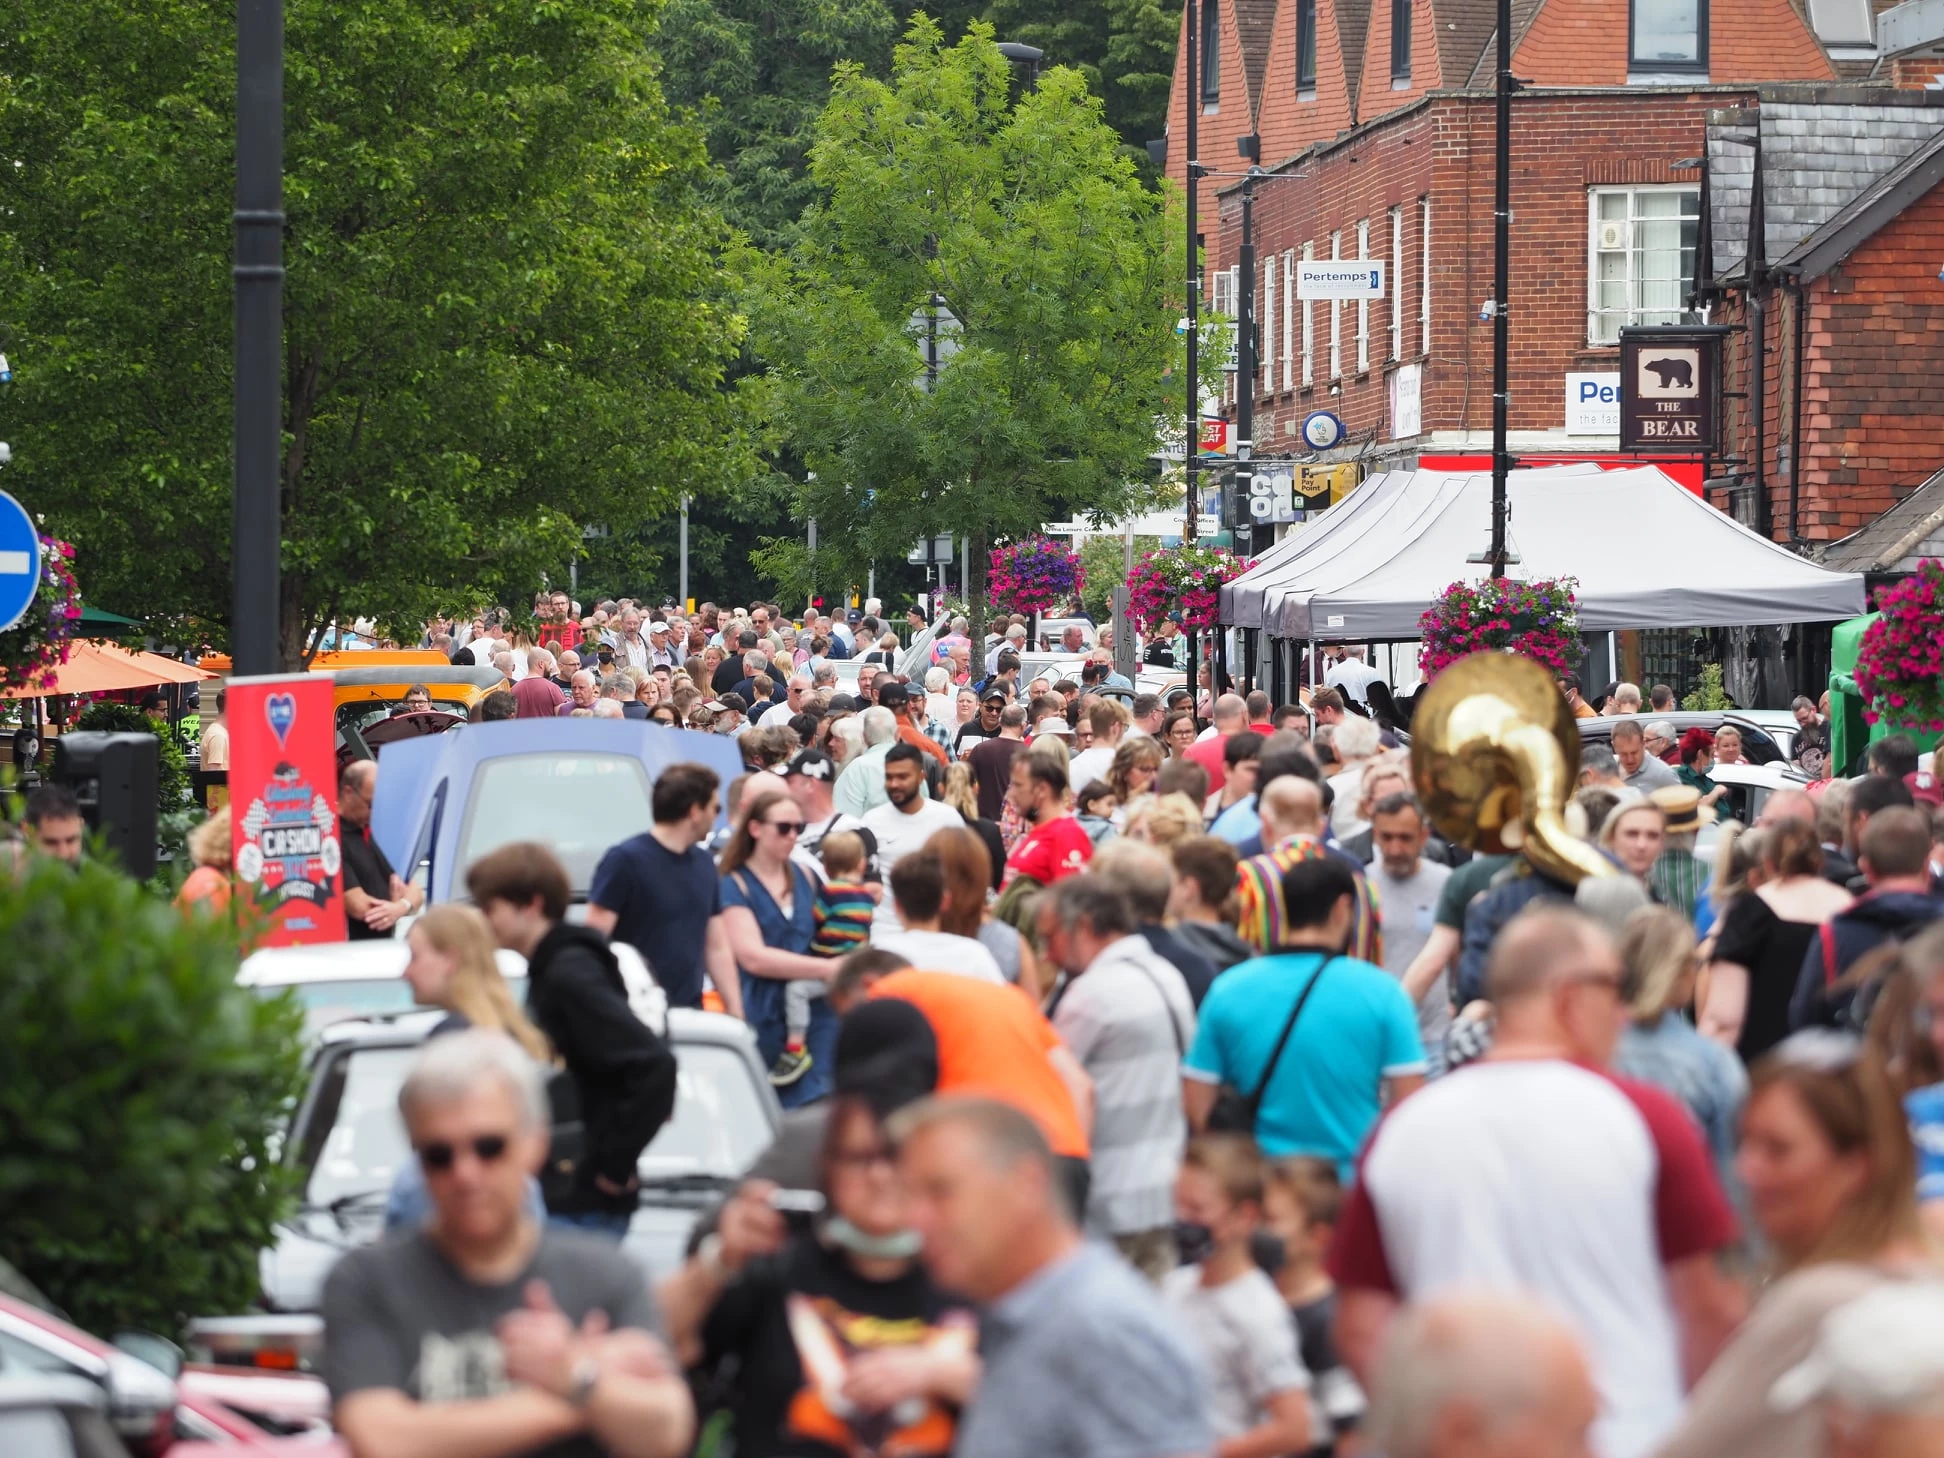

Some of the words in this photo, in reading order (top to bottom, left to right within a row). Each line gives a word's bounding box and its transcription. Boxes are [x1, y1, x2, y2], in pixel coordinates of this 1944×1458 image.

[1303, 272, 1367, 282] Pertemps
[1655, 401, 1681, 412] THE
[1579, 413, 1597, 424] the
[1642, 420, 1698, 436] BEAR
[1301, 479, 1314, 489] Pay
